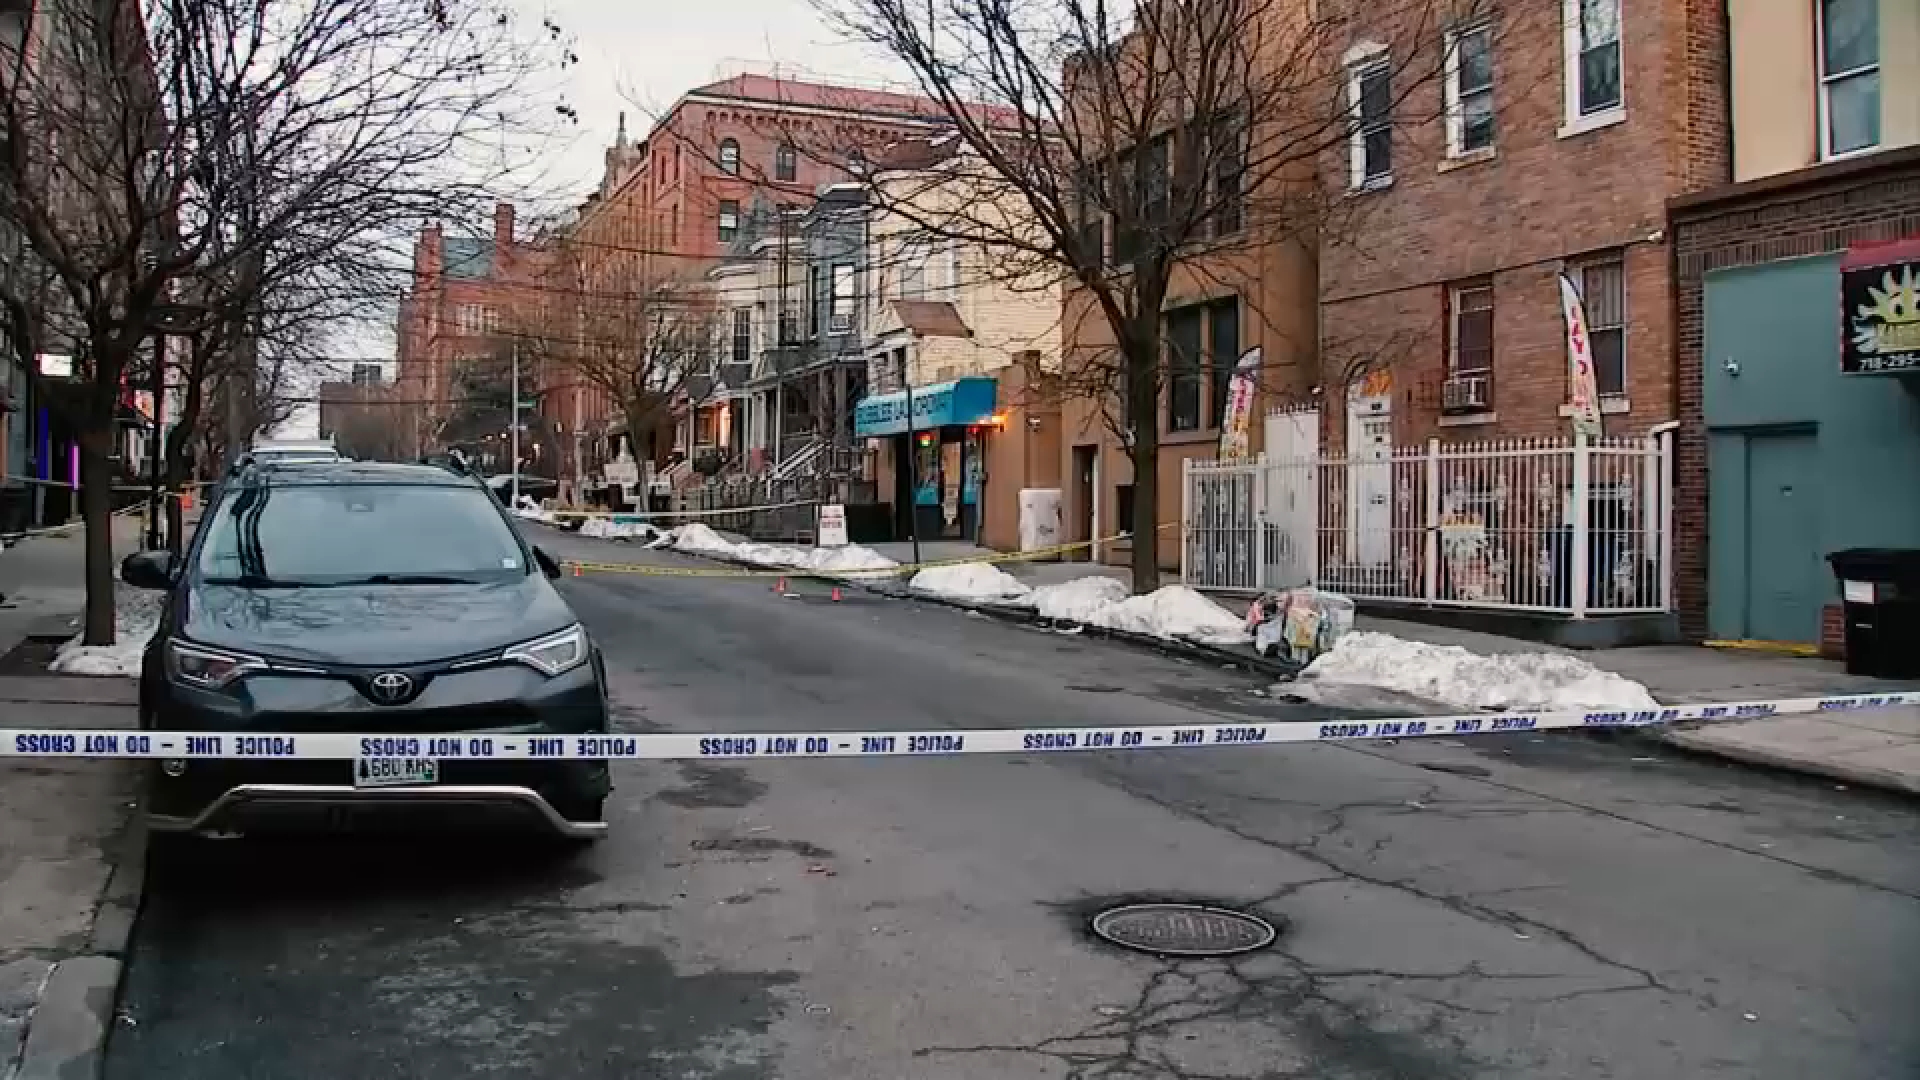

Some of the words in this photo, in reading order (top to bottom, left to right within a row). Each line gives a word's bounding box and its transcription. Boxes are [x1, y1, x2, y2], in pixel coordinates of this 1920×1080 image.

[1320, 724, 1368, 738] CROSS
[1374, 723, 1401, 735] NOT
[1405, 722, 1426, 734] DO
[1453, 720, 1482, 732] LINE
[1492, 717, 1537, 730] POLICE
[16, 734, 75, 752] CROSS
[907, 736, 964, 751] POLICE
[1023, 733, 1076, 749] CROSS
[1082, 732, 1114, 747] NOT
[1120, 732, 1143, 746] DO
[1172, 729, 1204, 745] LINE
[1216, 728, 1266, 743] POLICE
[84, 735, 118, 753] NOT
[126, 736, 150, 753] DO
[186, 736, 222, 754] LINE
[235, 737, 296, 755] POLICE
[360, 738, 420, 756] CROSS
[427, 738, 462, 755] NOT
[470, 738, 493, 755] DO
[527, 738, 564, 756] LINE
[577, 739, 637, 756] POLICE
[699, 738, 757, 754] CROSS
[764, 738, 798, 754] NOT
[806, 738, 829, 754] DO
[861, 736, 895, 752] LINE
